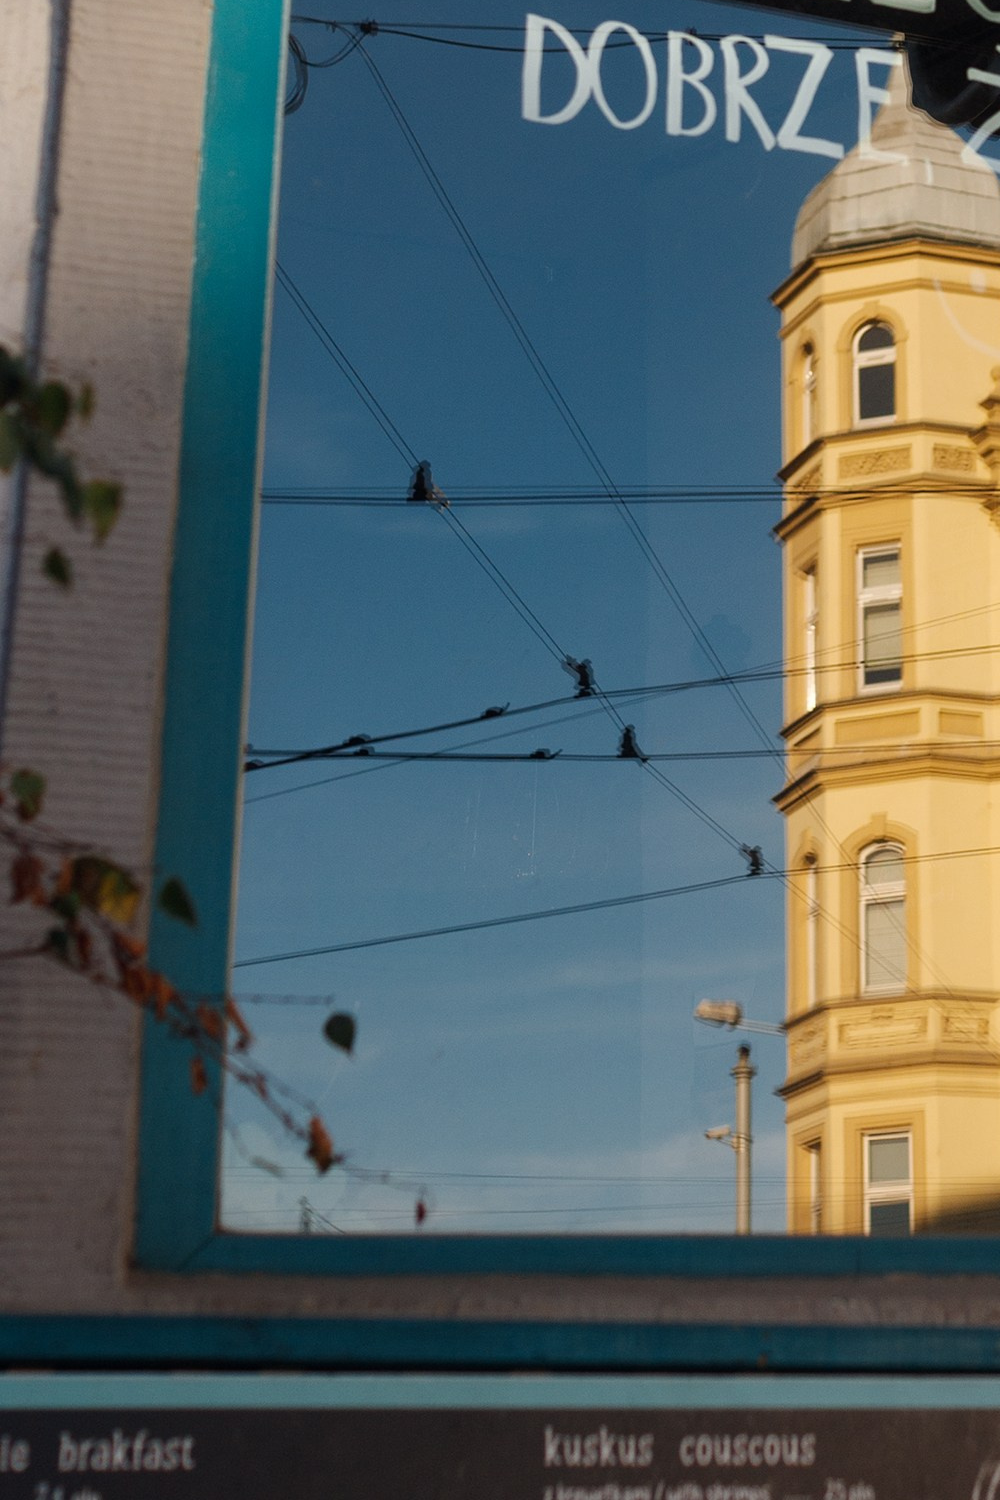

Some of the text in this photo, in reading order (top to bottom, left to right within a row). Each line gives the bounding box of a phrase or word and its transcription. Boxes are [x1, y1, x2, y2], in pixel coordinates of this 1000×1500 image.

[57, 1427, 196, 1473] brakfast
[544, 1423, 817, 1468] kuskus couscous
